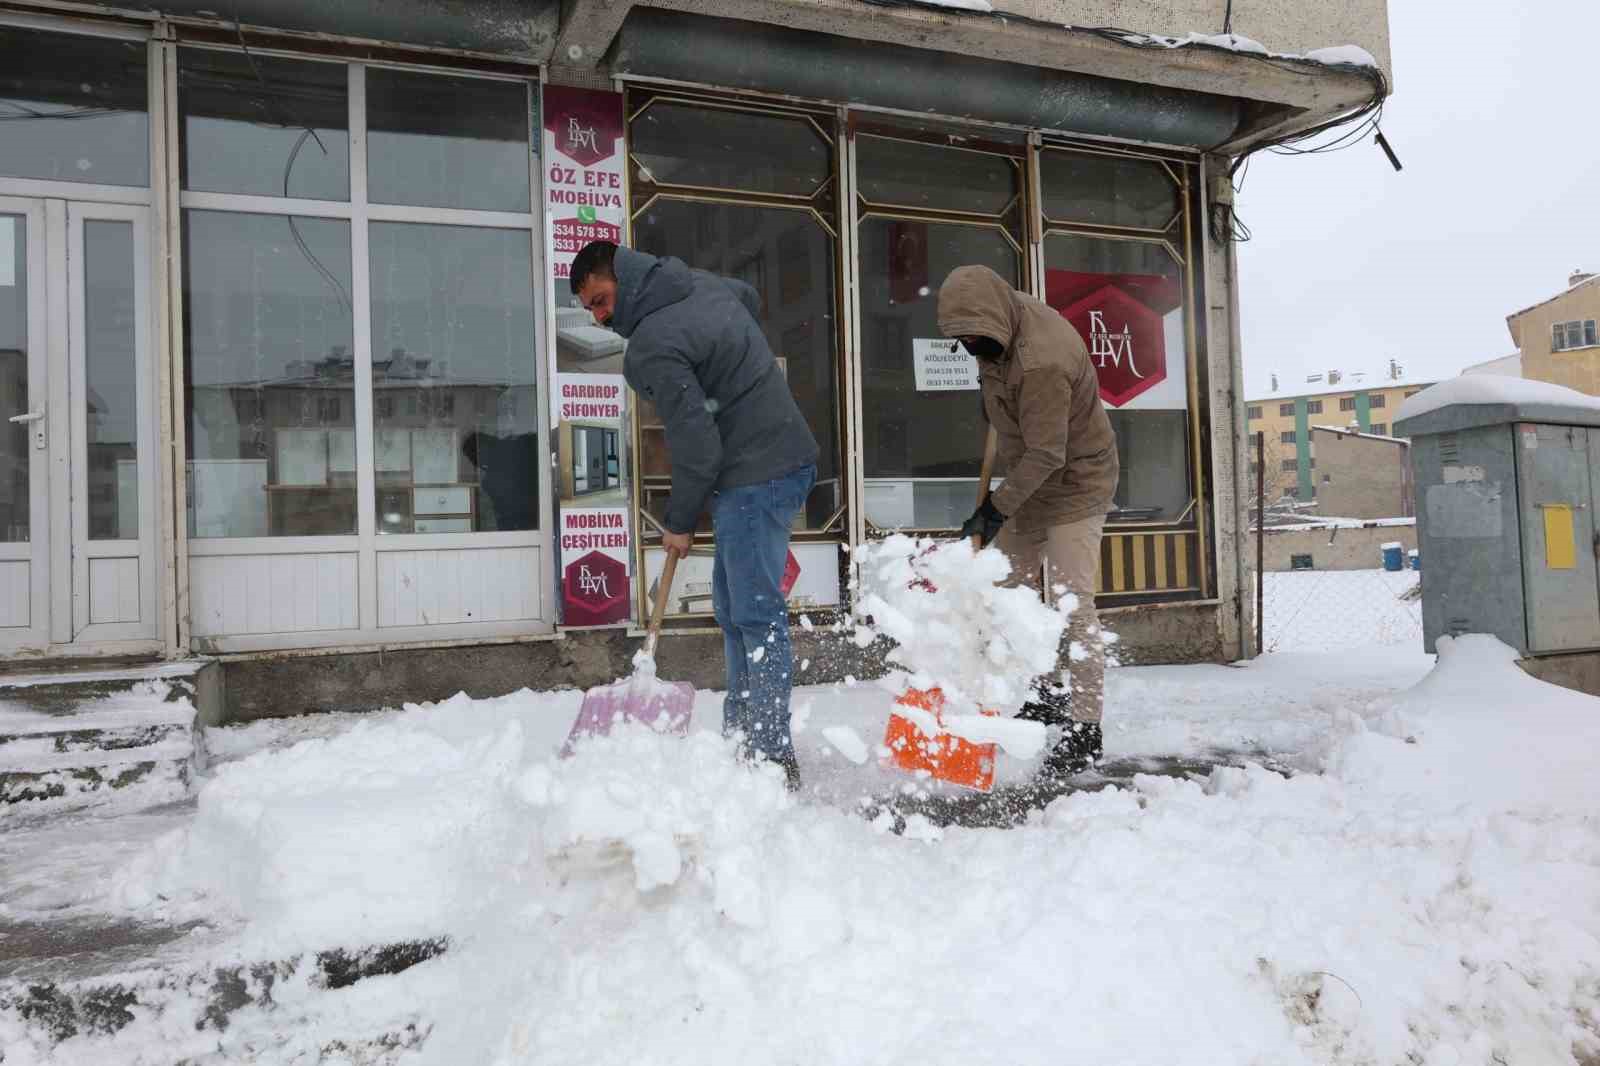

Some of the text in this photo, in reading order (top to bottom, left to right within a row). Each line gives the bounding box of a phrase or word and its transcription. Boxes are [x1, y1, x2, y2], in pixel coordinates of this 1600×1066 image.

[550, 162, 620, 189] ÖZ EFE
[550, 188, 622, 208] MOBİLYA
[577, 225, 595, 238] 578
[597, 227, 609, 239] 35
[562, 384, 619, 399] GARDROP
[562, 402, 619, 420] ŞİFONYER
[566, 511, 623, 529] MOBİLYA
[562, 532, 629, 551] ÇEŞİTLERİ
